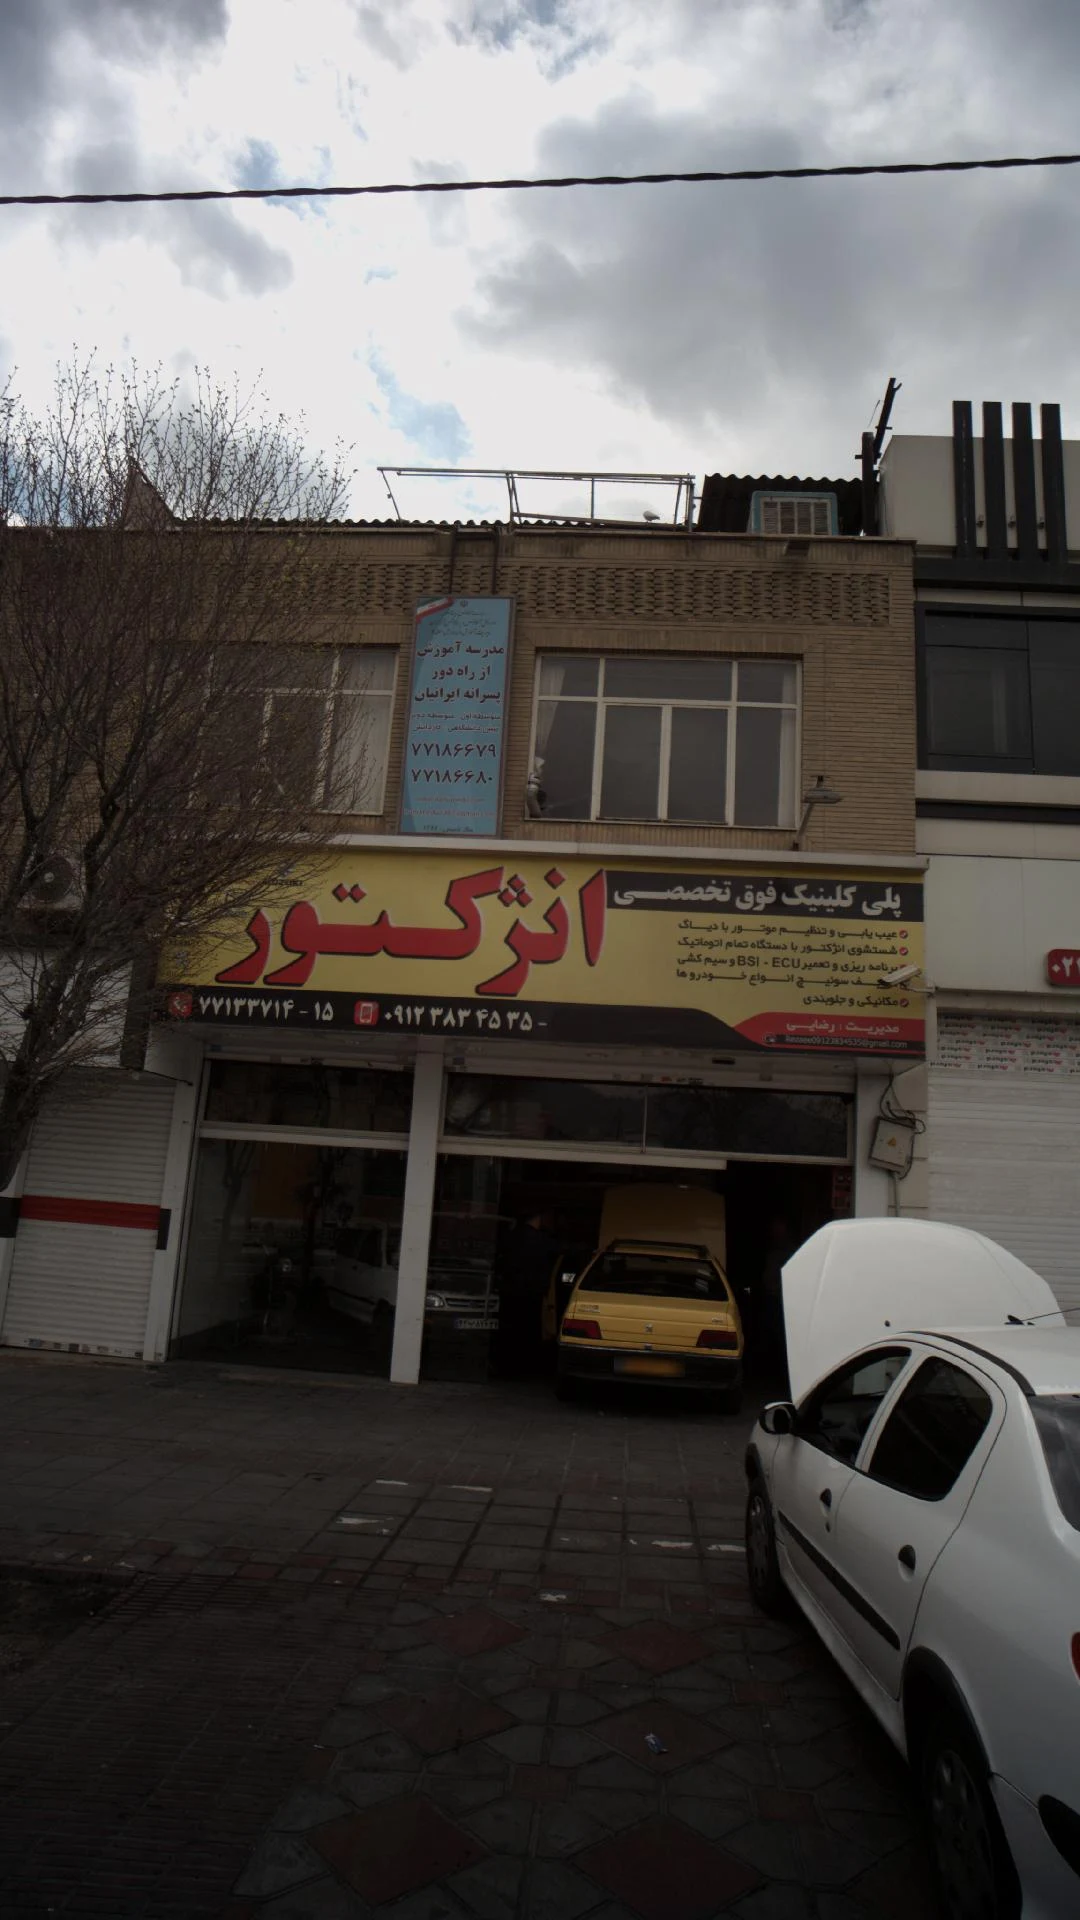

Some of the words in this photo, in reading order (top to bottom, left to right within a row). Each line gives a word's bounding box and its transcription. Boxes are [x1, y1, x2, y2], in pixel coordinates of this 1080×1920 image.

[417, 641, 461, 658] آموزش
[465, 645, 504, 658] مدرسه
[431, 666, 454, 681] دور
[457, 665, 476, 680] راه
[479, 665, 491, 681] از
[414, 687, 460, 703] ایرانیان
[463, 687, 501, 704] پسرانه
[411, 743, 497, 757] ۷۷۱۸۶۶۷۹
[411, 769, 494, 784] ۷۷۱۸۶۶۸۰
[613, 880, 732, 906] تخصصی
[735, 881, 777, 911] فوق
[782, 884, 857, 913] کلینیک
[862, 886, 901, 918] پلی
[215, 866, 608, 996] انژکتور
[679, 919, 718, 932] دیاگ
[721, 922, 728, 933] با
[731, 924, 776, 934] موتور
[779, 926, 827, 936] تنظیم
[830, 929, 835, 937] و
[838, 929, 873, 938] یابی
[875, 931, 897, 940] عیب
[678, 937, 723, 949] اتوماتیک
[726, 940, 748, 950] تمام
[750, 940, 788, 950] دستگاه
[791, 942, 798, 951] با
[801, 943, 845, 954] انژکتور
[848, 945, 897, 956] شستشوی
[678, 953, 702, 964] کشی
[704, 956, 727, 966] سیم
[730, 958, 735, 967] و
[738, 956, 759, 967] BSI
[772, 957, 800, 968] ECU
[802, 960, 830, 970] تعمیر
[832, 963, 838, 971] و
[841, 961, 865, 972] ریزی
[750, 973, 794, 985] انواع
[803, 995, 846, 1005] جلوبندی
[849, 998, 855, 1006] و
[857, 996, 898, 1007] مکانیکی
[199, 996, 294, 1020] ۷۷۱۳۳۷۱۴
[314, 1001, 334, 1021] ۱۵
[385, 1005, 425, 1026] ۰۹۱۲
[431, 1007, 471, 1028] ۳۸۳
[476, 1009, 501, 1030] ۴۵
[506, 1011, 533, 1031] ۳۵
[786, 1019, 835, 1032] رضایی
[846, 1021, 899, 1035] مدیریت
